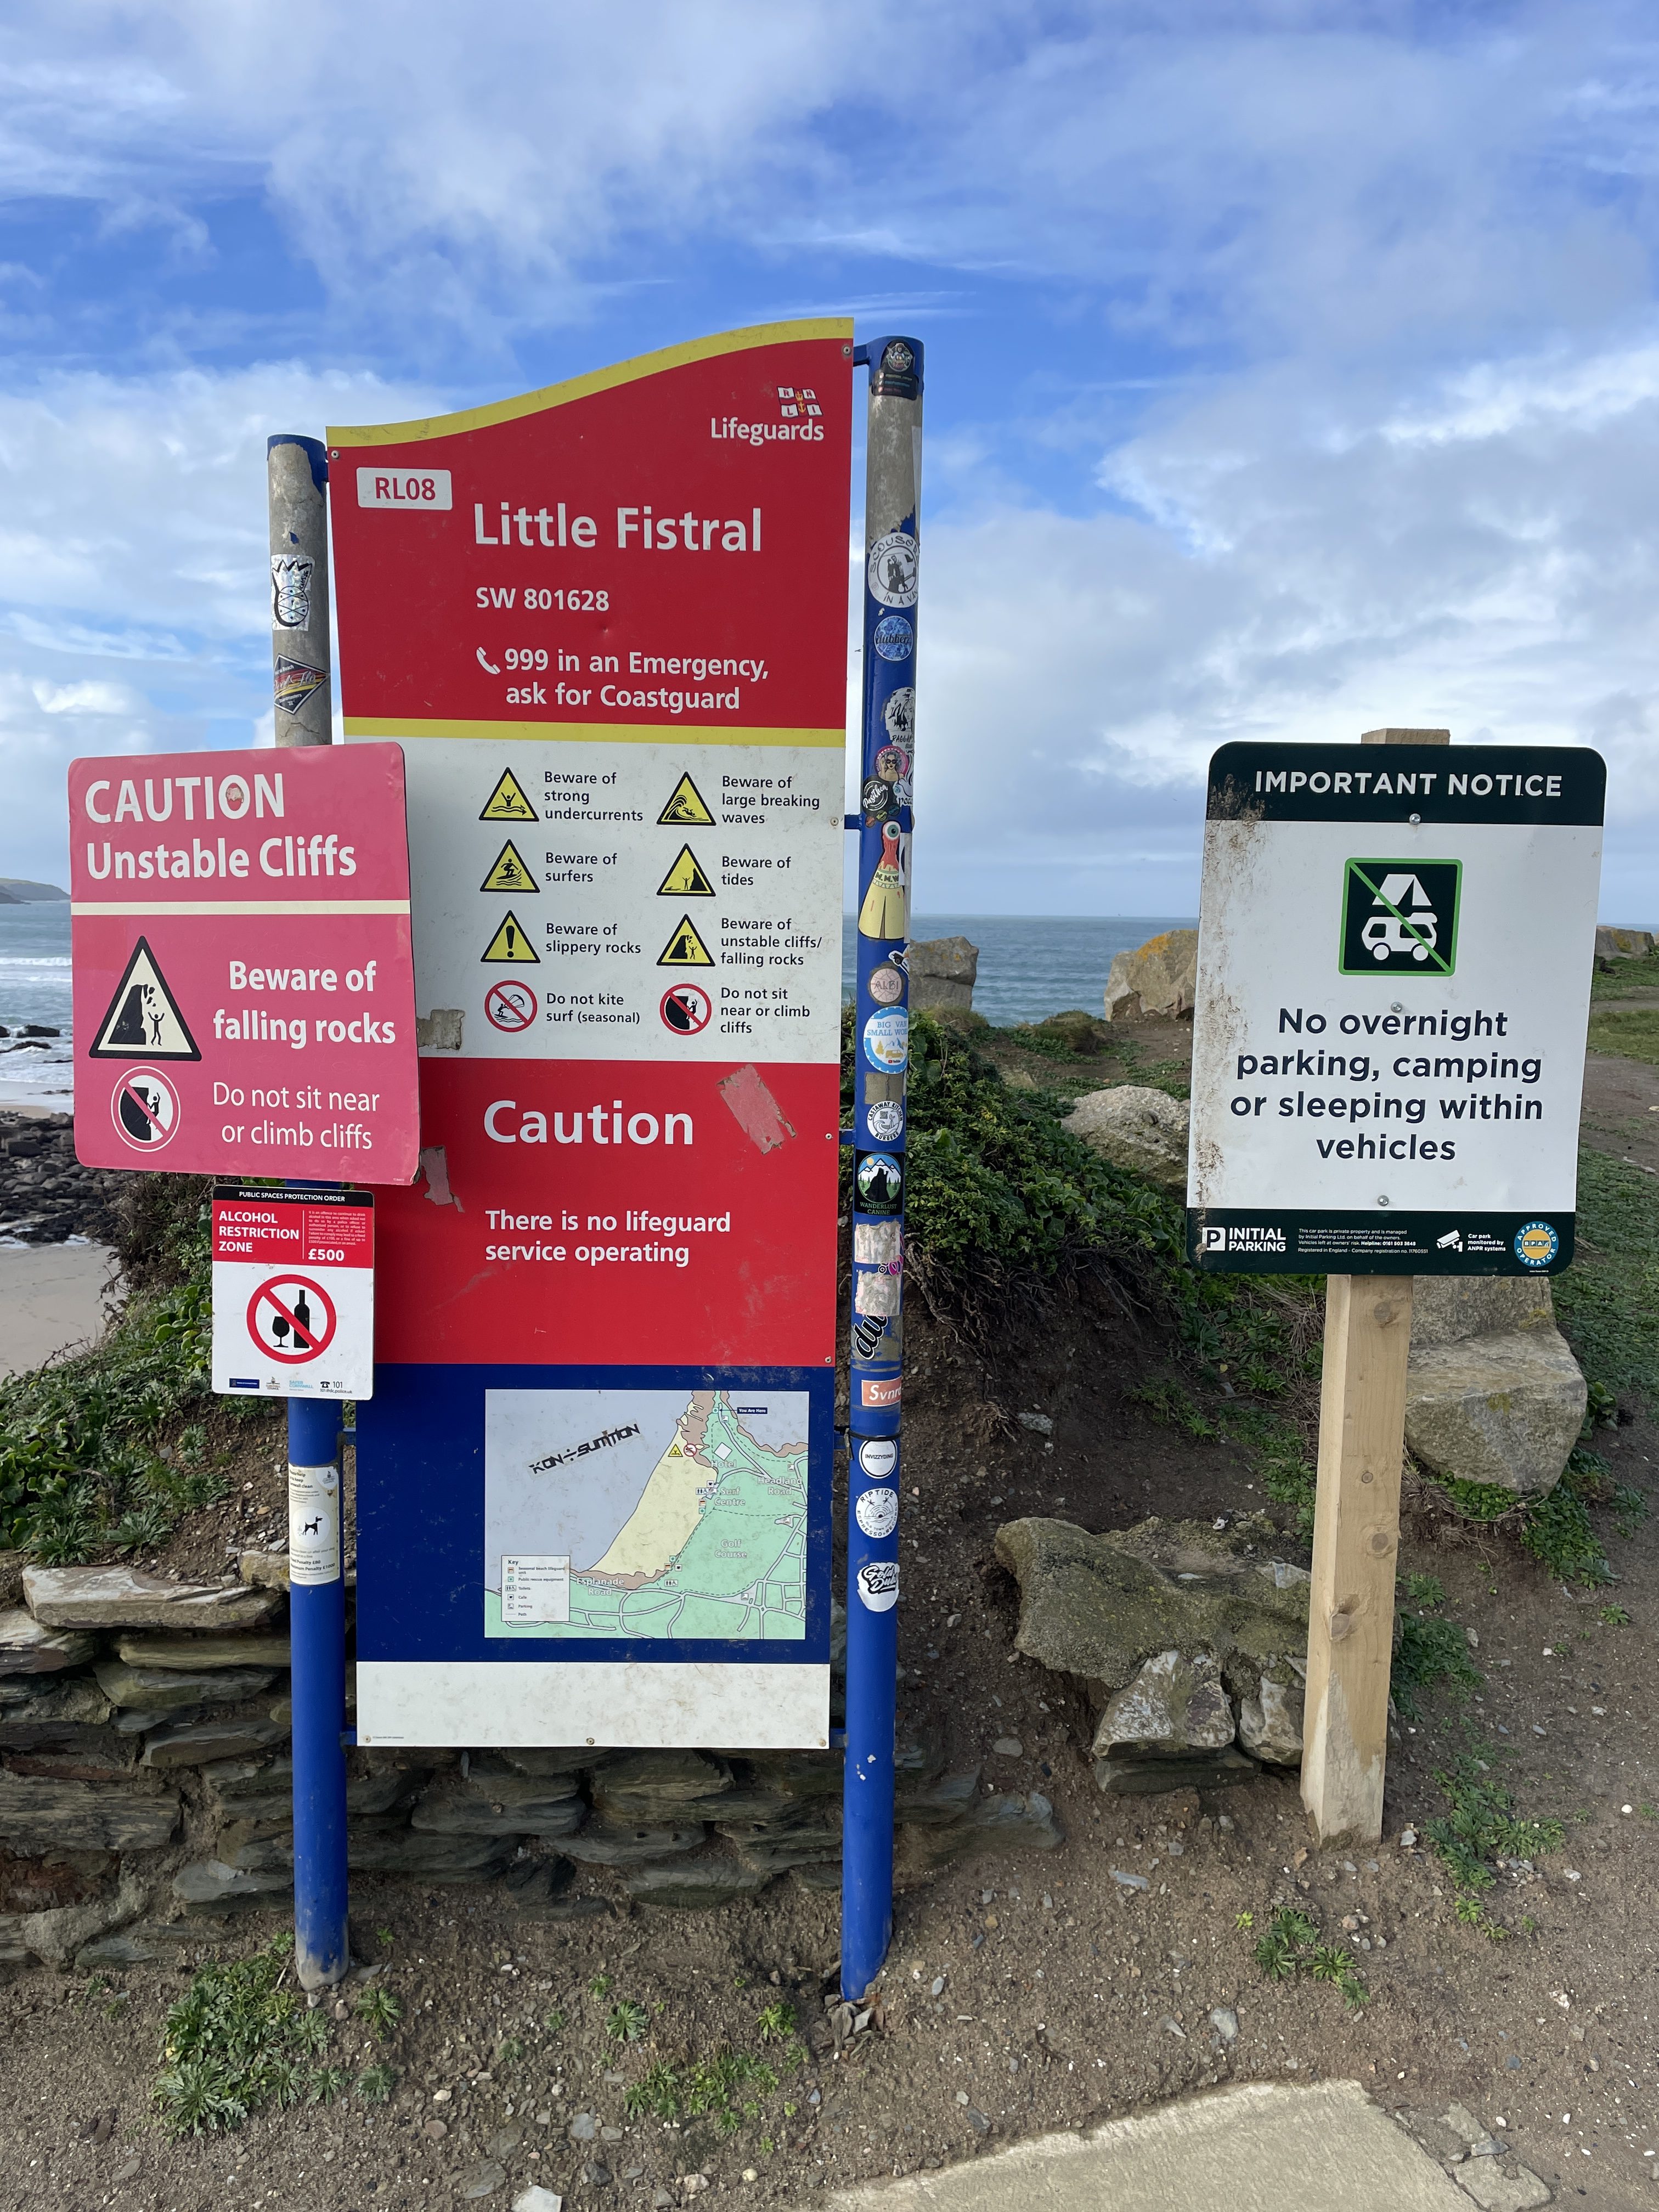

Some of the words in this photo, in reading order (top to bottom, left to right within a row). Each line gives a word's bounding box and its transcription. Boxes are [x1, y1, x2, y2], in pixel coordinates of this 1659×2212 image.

[711, 416, 824, 446] Lifeguards
[375, 477, 436, 501] RL08
[474, 501, 597, 548] Little
[617, 505, 761, 552] Fistral
[476, 586, 516, 608] SW
[524, 588, 610, 611] 801628
[883, 591, 893, 604] IN
[899, 595, 904, 605] A
[505, 648, 549, 671] 999
[558, 648, 580, 672] in
[589, 656, 619, 673] an
[629, 652, 769, 682] Emergency,
[506, 681, 547, 704] ask
[555, 682, 592, 706] for
[600, 685, 740, 714] Coastguard
[544, 771, 597, 784] Beware
[602, 772, 617, 785] of
[723, 775, 773, 788] Beware
[777, 776, 792, 788] of
[1255, 771, 1437, 794] IMPORTANT
[1448, 774, 1562, 797] NOTICE
[85, 773, 284, 823] CAUTION
[544, 790, 589, 805] strong
[722, 793, 756, 809] large
[761, 793, 820, 810] breaking
[545, 807, 644, 821] undercurrents
[721, 814, 765, 824] waves
[87, 838, 250, 879] Unstable
[259, 834, 357, 877] Cliffs
[546, 852, 598, 865] Beware
[602, 853, 618, 865] of
[722, 856, 772, 868] Beware
[777, 856, 791, 868] of
[545, 870, 593, 882] surfers
[721, 873, 754, 885] tides
[546, 923, 598, 935] Beware
[603, 923, 618, 935] of
[721, 917, 772, 930] Beware
[777, 918, 792, 930] of
[546, 940, 601, 956] slippery
[606, 941, 641, 953] rocks
[721, 935, 780, 947] unstable
[785, 935, 822, 949] cliffs/
[720, 952, 764, 968] falling
[769, 953, 804, 966] rocks
[229, 961, 337, 991] Beware
[345, 960, 377, 992] of
[547, 992, 566, 1004] Do
[571, 994, 594, 1005] not
[599, 992, 624, 1005] kite
[721, 987, 740, 998] Do
[744, 989, 768, 999] not
[771, 988, 788, 1000] sit
[546, 1009, 574, 1022] surf
[578, 1011, 640, 1025] (seasonal)
[721, 1007, 752, 1016] near
[755, 1008, 770, 1017] or
[774, 1005, 810, 1017] climb
[213, 1009, 307, 1049] falling
[315, 1012, 396, 1044] rocks
[720, 1021, 752, 1034] cliffs
[1279, 1008, 1327, 1034] No
[1339, 1009, 1508, 1041] overnight
[1237, 1049, 1379, 1082] parking,
[1393, 1052, 1542, 1084] camping
[213, 1082, 245, 1106] Do
[252, 1087, 290, 1108] not
[296, 1085, 322, 1109] sit
[329, 1092, 380, 1111] near
[868, 1102, 890, 1121] CASTAWAY
[1230, 1096, 1264, 1118] or
[1278, 1091, 1426, 1124] sleeping
[1439, 1093, 1542, 1120] within
[484, 1100, 693, 1145] Caution
[222, 1125, 245, 1143] or
[251, 1120, 313, 1147] climb
[320, 1122, 372, 1149] cliffs
[1316, 1133, 1455, 1160] vehicles
[218, 1210, 278, 1223] ALCOHOL
[485, 1209, 552, 1231] There
[562, 1210, 578, 1231] is
[588, 1216, 617, 1231] no
[626, 1210, 730, 1237] lifeguard
[219, 1226, 299, 1240] RESTRICTION
[1229, 1228, 1286, 1240] INITIAL
[1517, 1223, 1556, 1242] APPROVED
[218, 1241, 253, 1252] ZONE
[308, 1248, 345, 1261] £500
[486, 1240, 567, 1261] service
[574, 1242, 689, 1267] operating
[1229, 1242, 1286, 1251] PARKING
[1517, 1248, 1556, 1265] OPERATOR
[758, 1476, 802, 1485] Headland
[860, 1489, 894, 1503] RIPTIDE
[721, 1539, 741, 1548] Golf
[715, 1550, 747, 1558] Course
[862, 1565, 895, 1581] Gold
[577, 1578, 624, 1587] Esplanade
